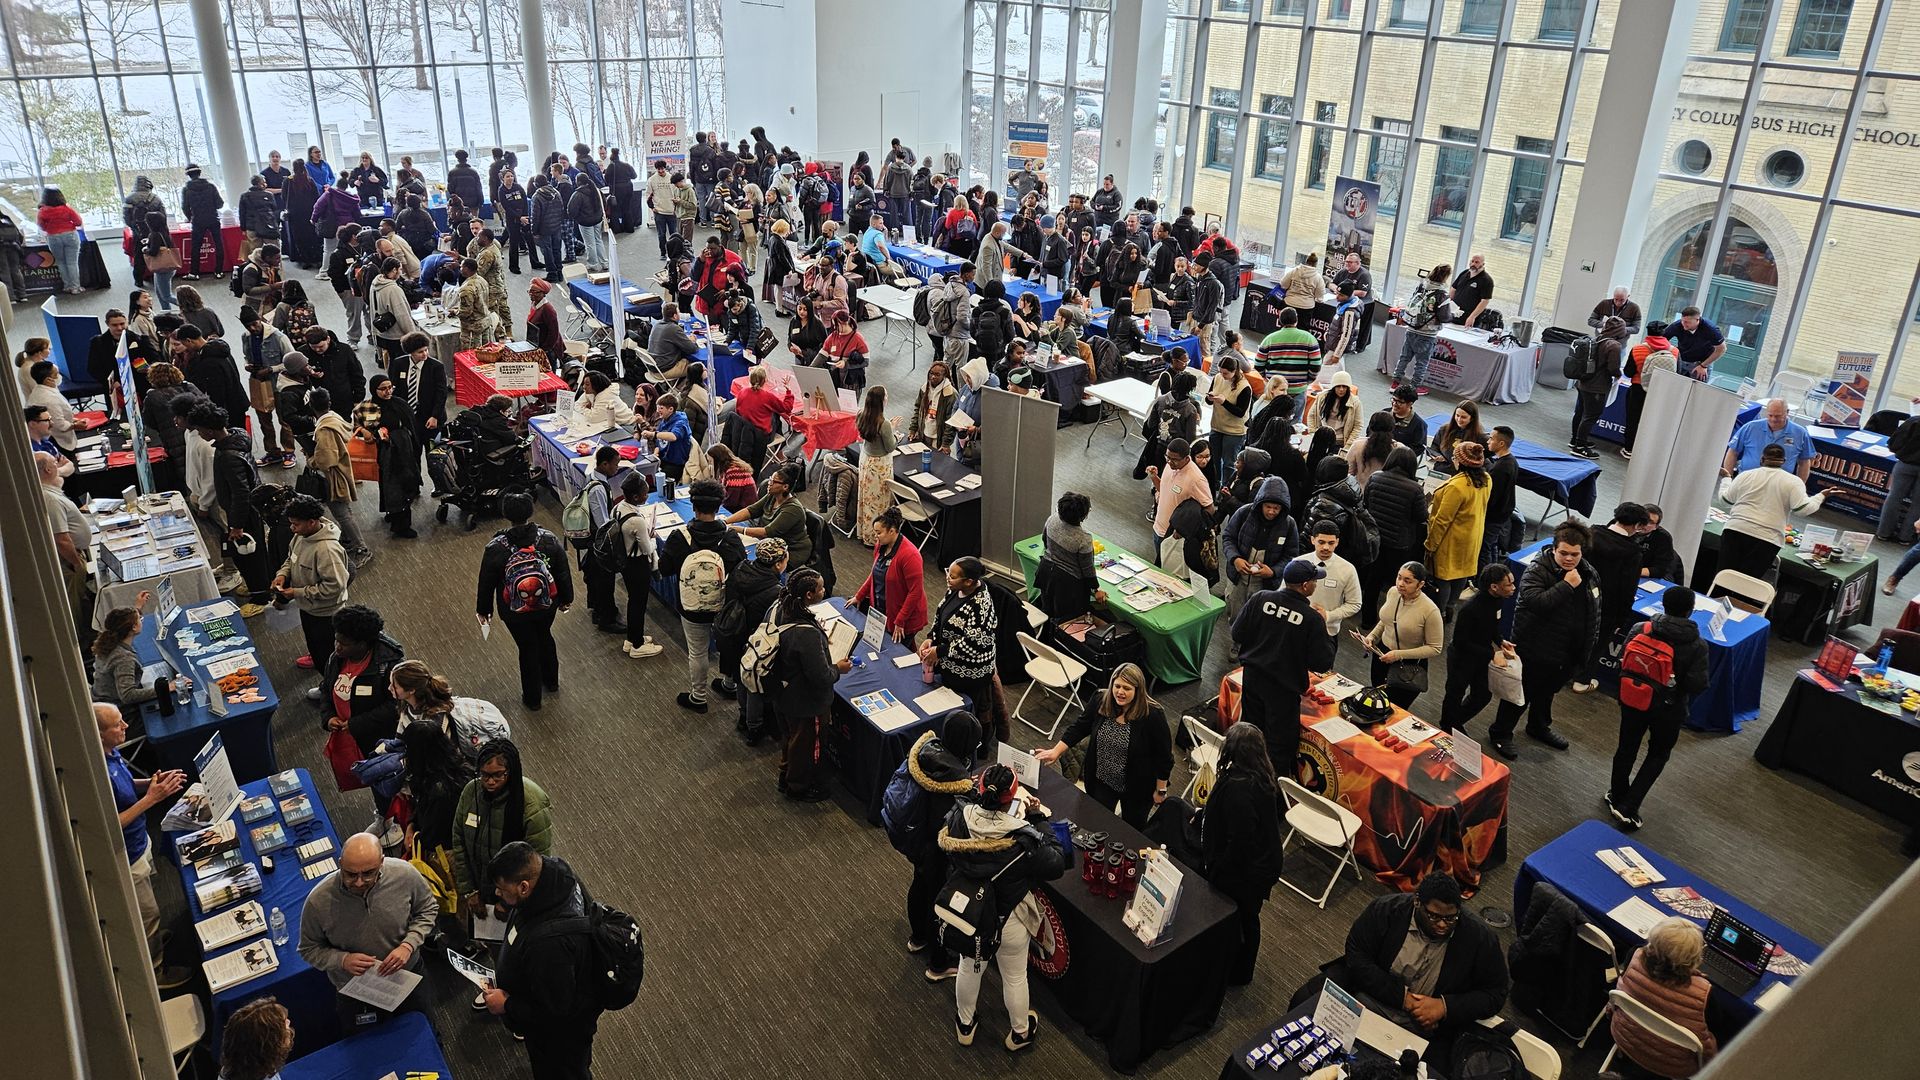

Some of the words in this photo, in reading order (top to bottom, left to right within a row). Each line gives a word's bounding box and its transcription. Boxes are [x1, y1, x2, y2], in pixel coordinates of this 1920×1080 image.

[1788, 120, 1836, 138] HIGH
[1854, 127, 1920, 147] CHOOL
[665, 139, 682, 147] ARE
[651, 146, 680, 154] HIRING!
[1839, 355, 1859, 364] BUILD
[1859, 357, 1873, 365] THE
[1837, 363, 1872, 372] FUTURE
[1809, 470, 1840, 482] nternational
[1811, 452, 1861, 480] BUILD
[1862, 467, 1887, 488] THE
[1262, 601, 1304, 625] CFD
[1039, 897, 1065, 953] COUNTY
